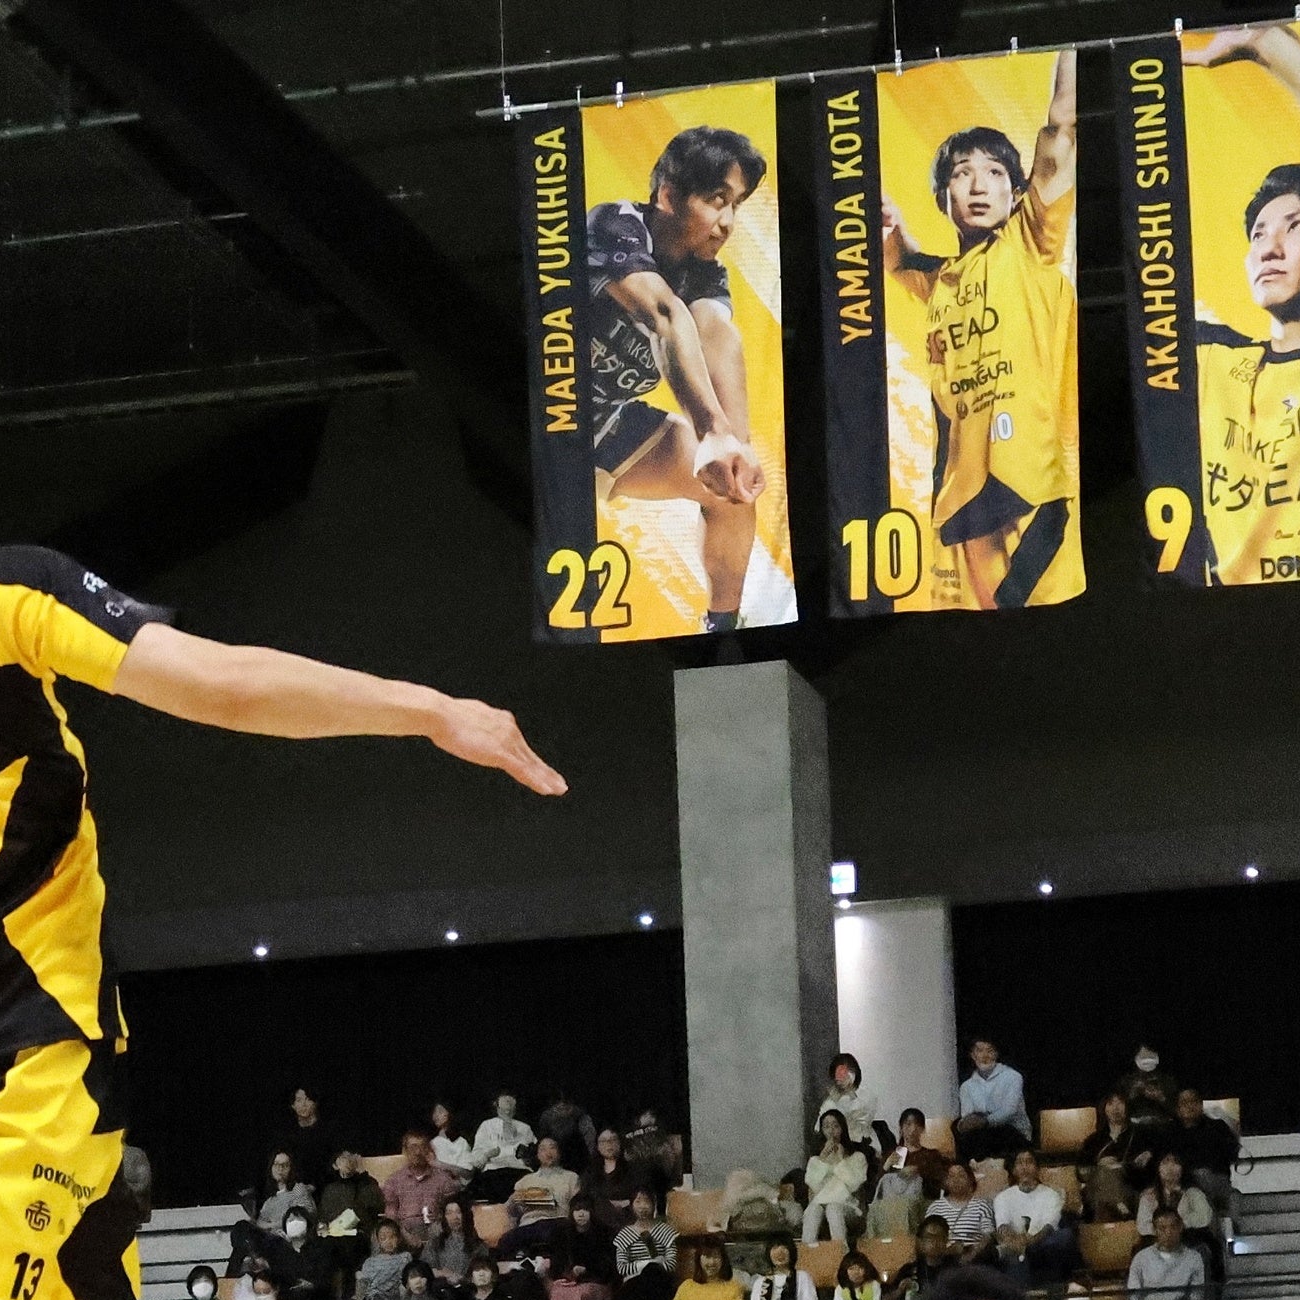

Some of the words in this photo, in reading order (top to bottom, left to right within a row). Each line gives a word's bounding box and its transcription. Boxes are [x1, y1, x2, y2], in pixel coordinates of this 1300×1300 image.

[828, 90, 861, 179] KOTA
[1129, 57, 1171, 190] SHINJO
[536, 126, 570, 291] YUKIHISA
[834, 192, 873, 345] YAMADA
[1139, 201, 1180, 390] AKAHOSHI
[544, 308, 578, 432] MAEDA
[544, 541, 631, 628] 22
[842, 511, 921, 602] 10
[1143, 485, 1193, 573] 9
